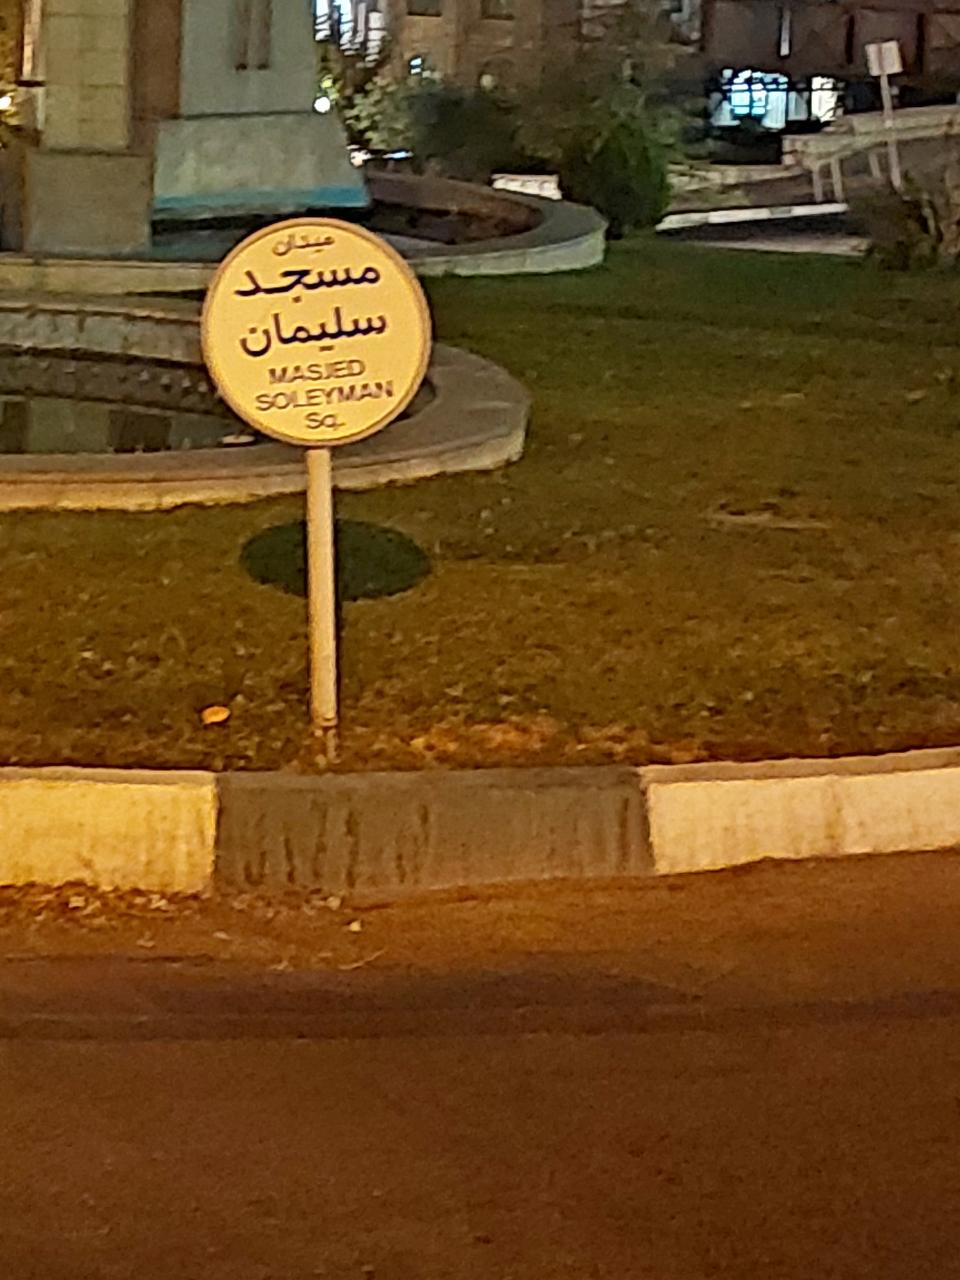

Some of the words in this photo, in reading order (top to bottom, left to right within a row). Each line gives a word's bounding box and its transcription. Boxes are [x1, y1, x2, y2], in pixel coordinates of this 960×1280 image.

[234, 266, 381, 303] مسجد
[240, 306, 387, 357] سلیمان
[268, 359, 366, 384] MASJED
[255, 380, 393, 411] SOLEYMAN
